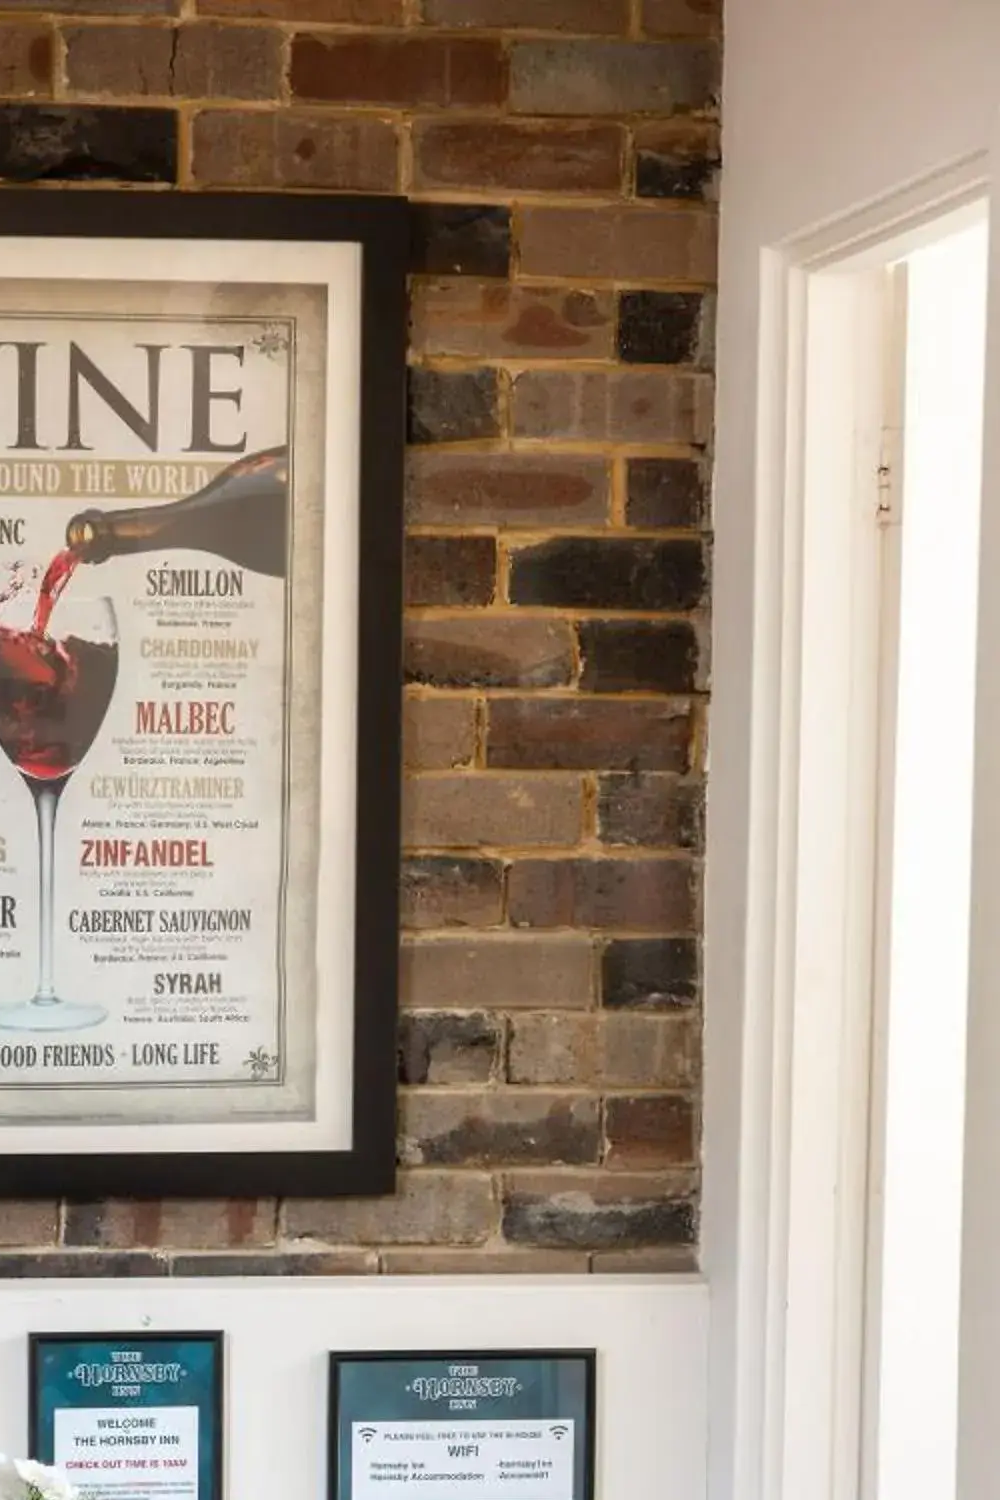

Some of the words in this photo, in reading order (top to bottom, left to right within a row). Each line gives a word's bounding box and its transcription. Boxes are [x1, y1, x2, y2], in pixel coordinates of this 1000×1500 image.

[71, 463, 116, 493] THE
[126, 464, 209, 494] WORLD
[146, 561, 243, 597] SÉMILLON
[140, 638, 259, 660] CHARDONNAY
[135, 701, 236, 735] MALBEC
[90, 772, 245, 799] GEWÜRZTRAMINER
[79, 839, 214, 867] ZINFANDEL
[69, 908, 155, 933] CABERNET
[159, 908, 252, 933] SAUVIGNON
[153, 972, 222, 995] SYRAH
[43, 1044, 115, 1067] FRIENDS
[132, 1043, 178, 1066] LONG
[183, 1043, 220, 1065] LIFE
[97, 1418, 157, 1429] WELCOME
[74, 1436, 97, 1447] THE
[100, 1436, 157, 1446] HORNSBY
[159, 1435, 180, 1445] INN
[447, 1445, 479, 1457] WIFI
[65, 1461, 100, 1469] CHECK
[102, 1460, 121, 1468] OUT
[125, 1460, 146, 1468] TIME
[150, 1459, 159, 1467] IS
